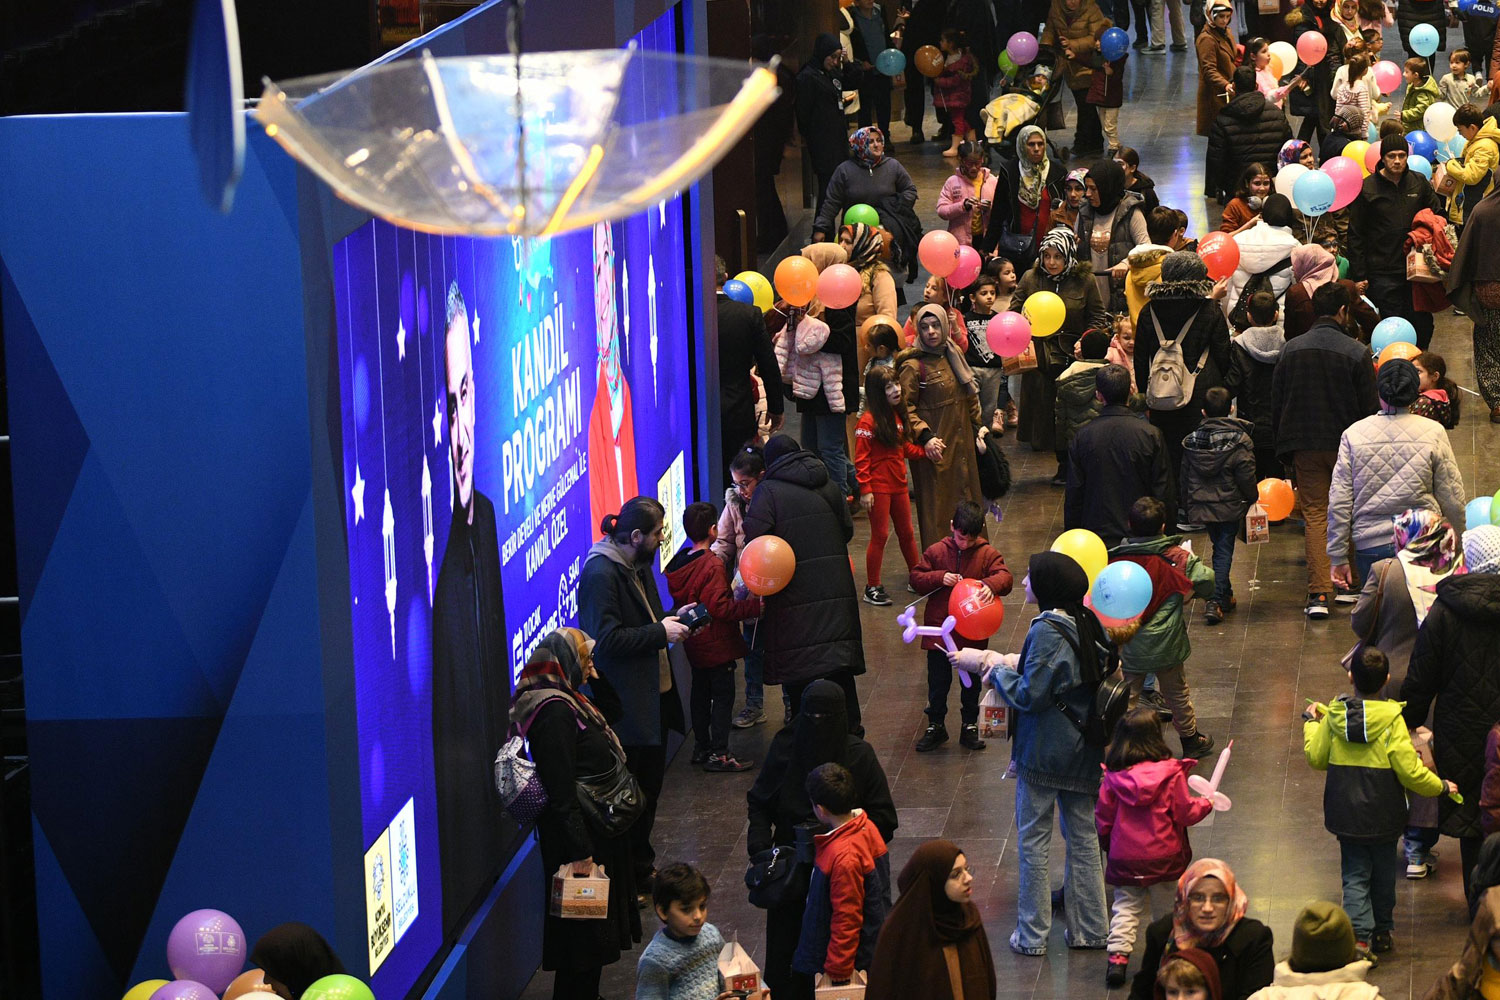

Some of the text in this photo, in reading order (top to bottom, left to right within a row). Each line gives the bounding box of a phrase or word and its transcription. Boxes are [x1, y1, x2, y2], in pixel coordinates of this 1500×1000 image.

[511, 291, 569, 418] KANDİL
[502, 366, 582, 515] PROGRAMI
[525, 506, 569, 582] KANDİL ÖZEL
[568, 555, 580, 585] SAAT
